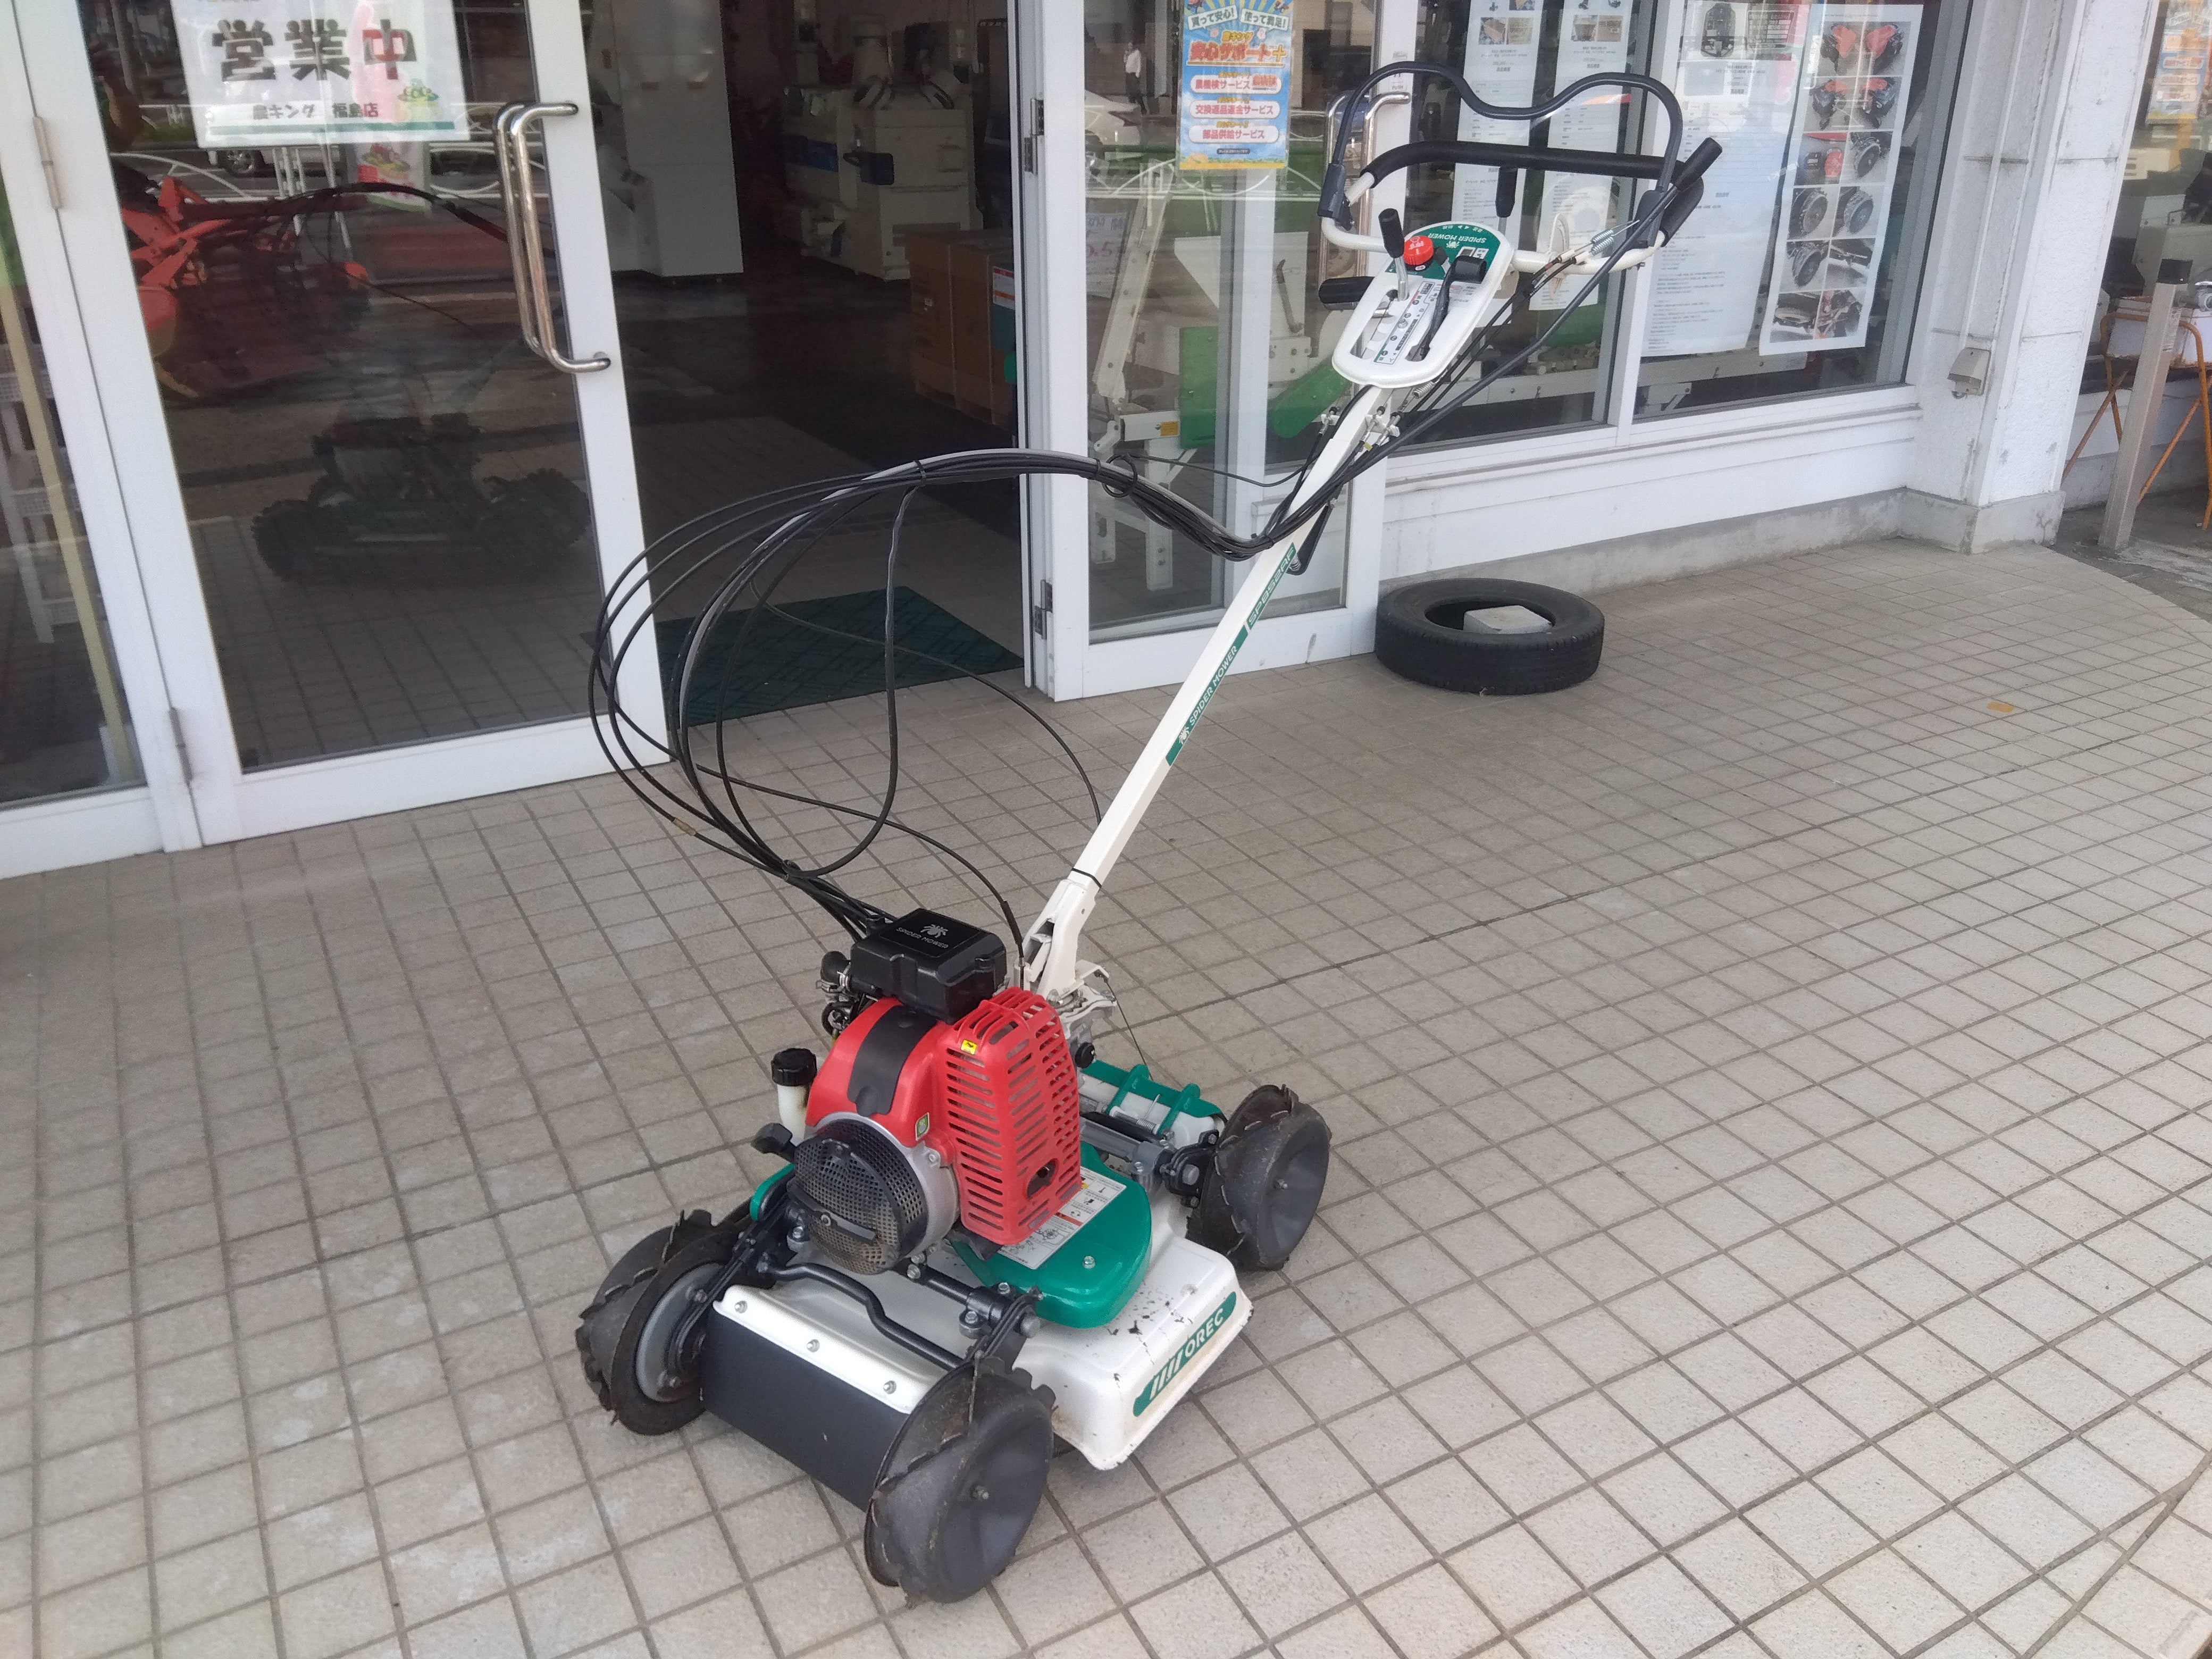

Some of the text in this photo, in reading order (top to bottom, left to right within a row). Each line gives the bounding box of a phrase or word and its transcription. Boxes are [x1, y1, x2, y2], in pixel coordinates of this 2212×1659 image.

[212, 19, 416, 82] 営業中
[1428, 233, 1487, 244] SPIDER MOWER
[1249, 547, 1294, 626] SP852AF
[1189, 645, 1237, 725] SPIDER MOWER
[895, 927, 949, 949] SPIDER MOWER
[1185, 1308, 1223, 1358] OREC
